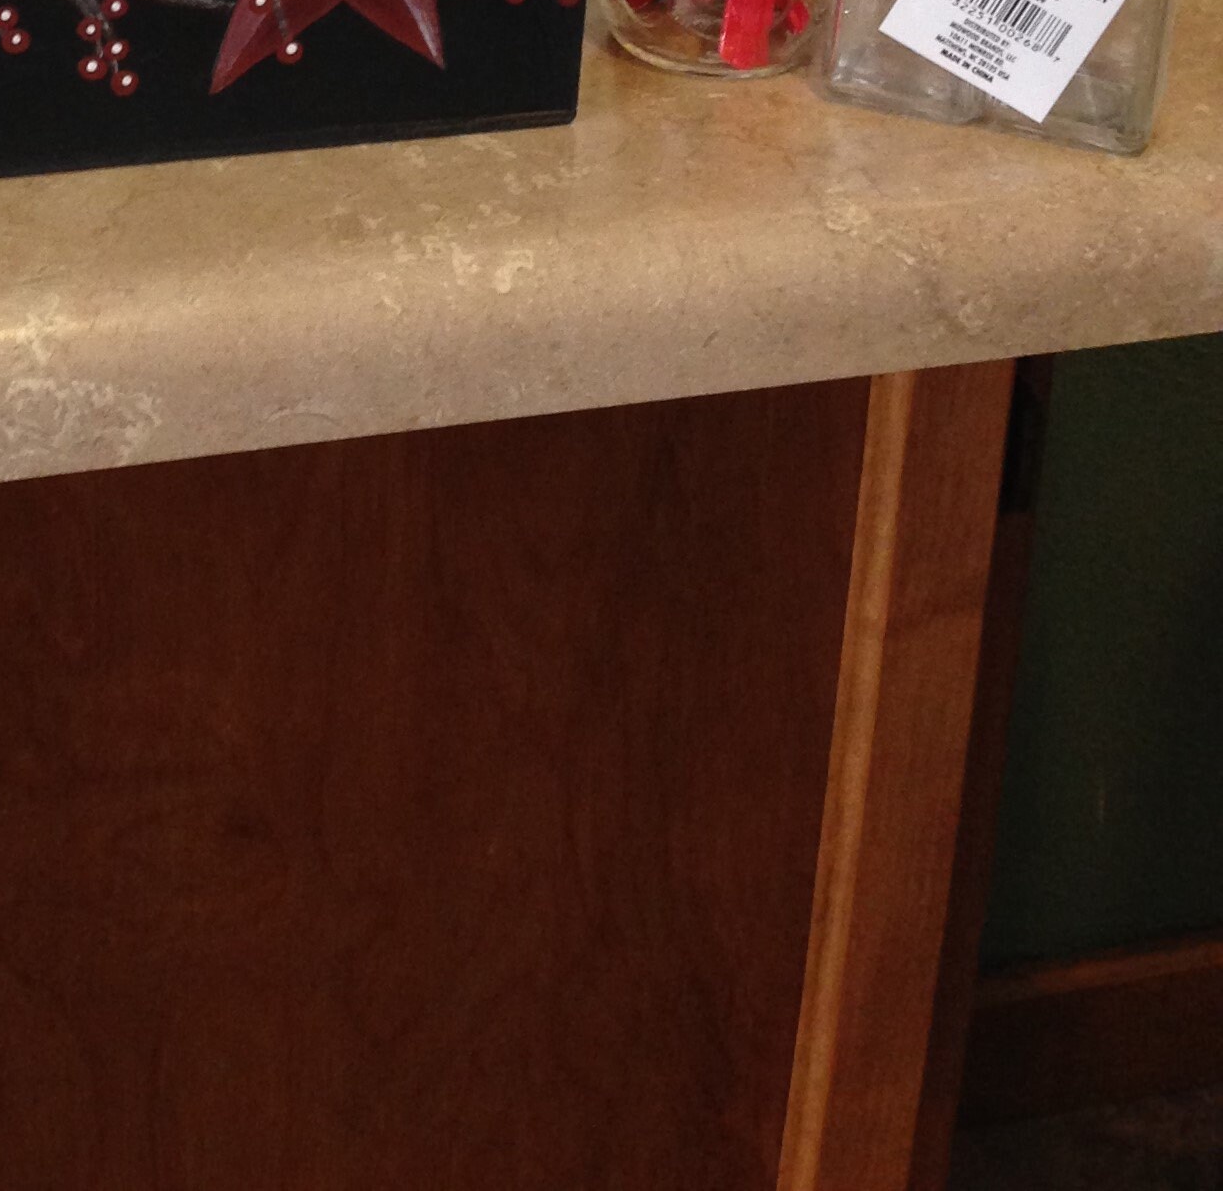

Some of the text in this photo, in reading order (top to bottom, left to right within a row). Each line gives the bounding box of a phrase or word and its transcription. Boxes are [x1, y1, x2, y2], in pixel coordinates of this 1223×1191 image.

[940, 48, 994, 83] MADE IN CHINA
